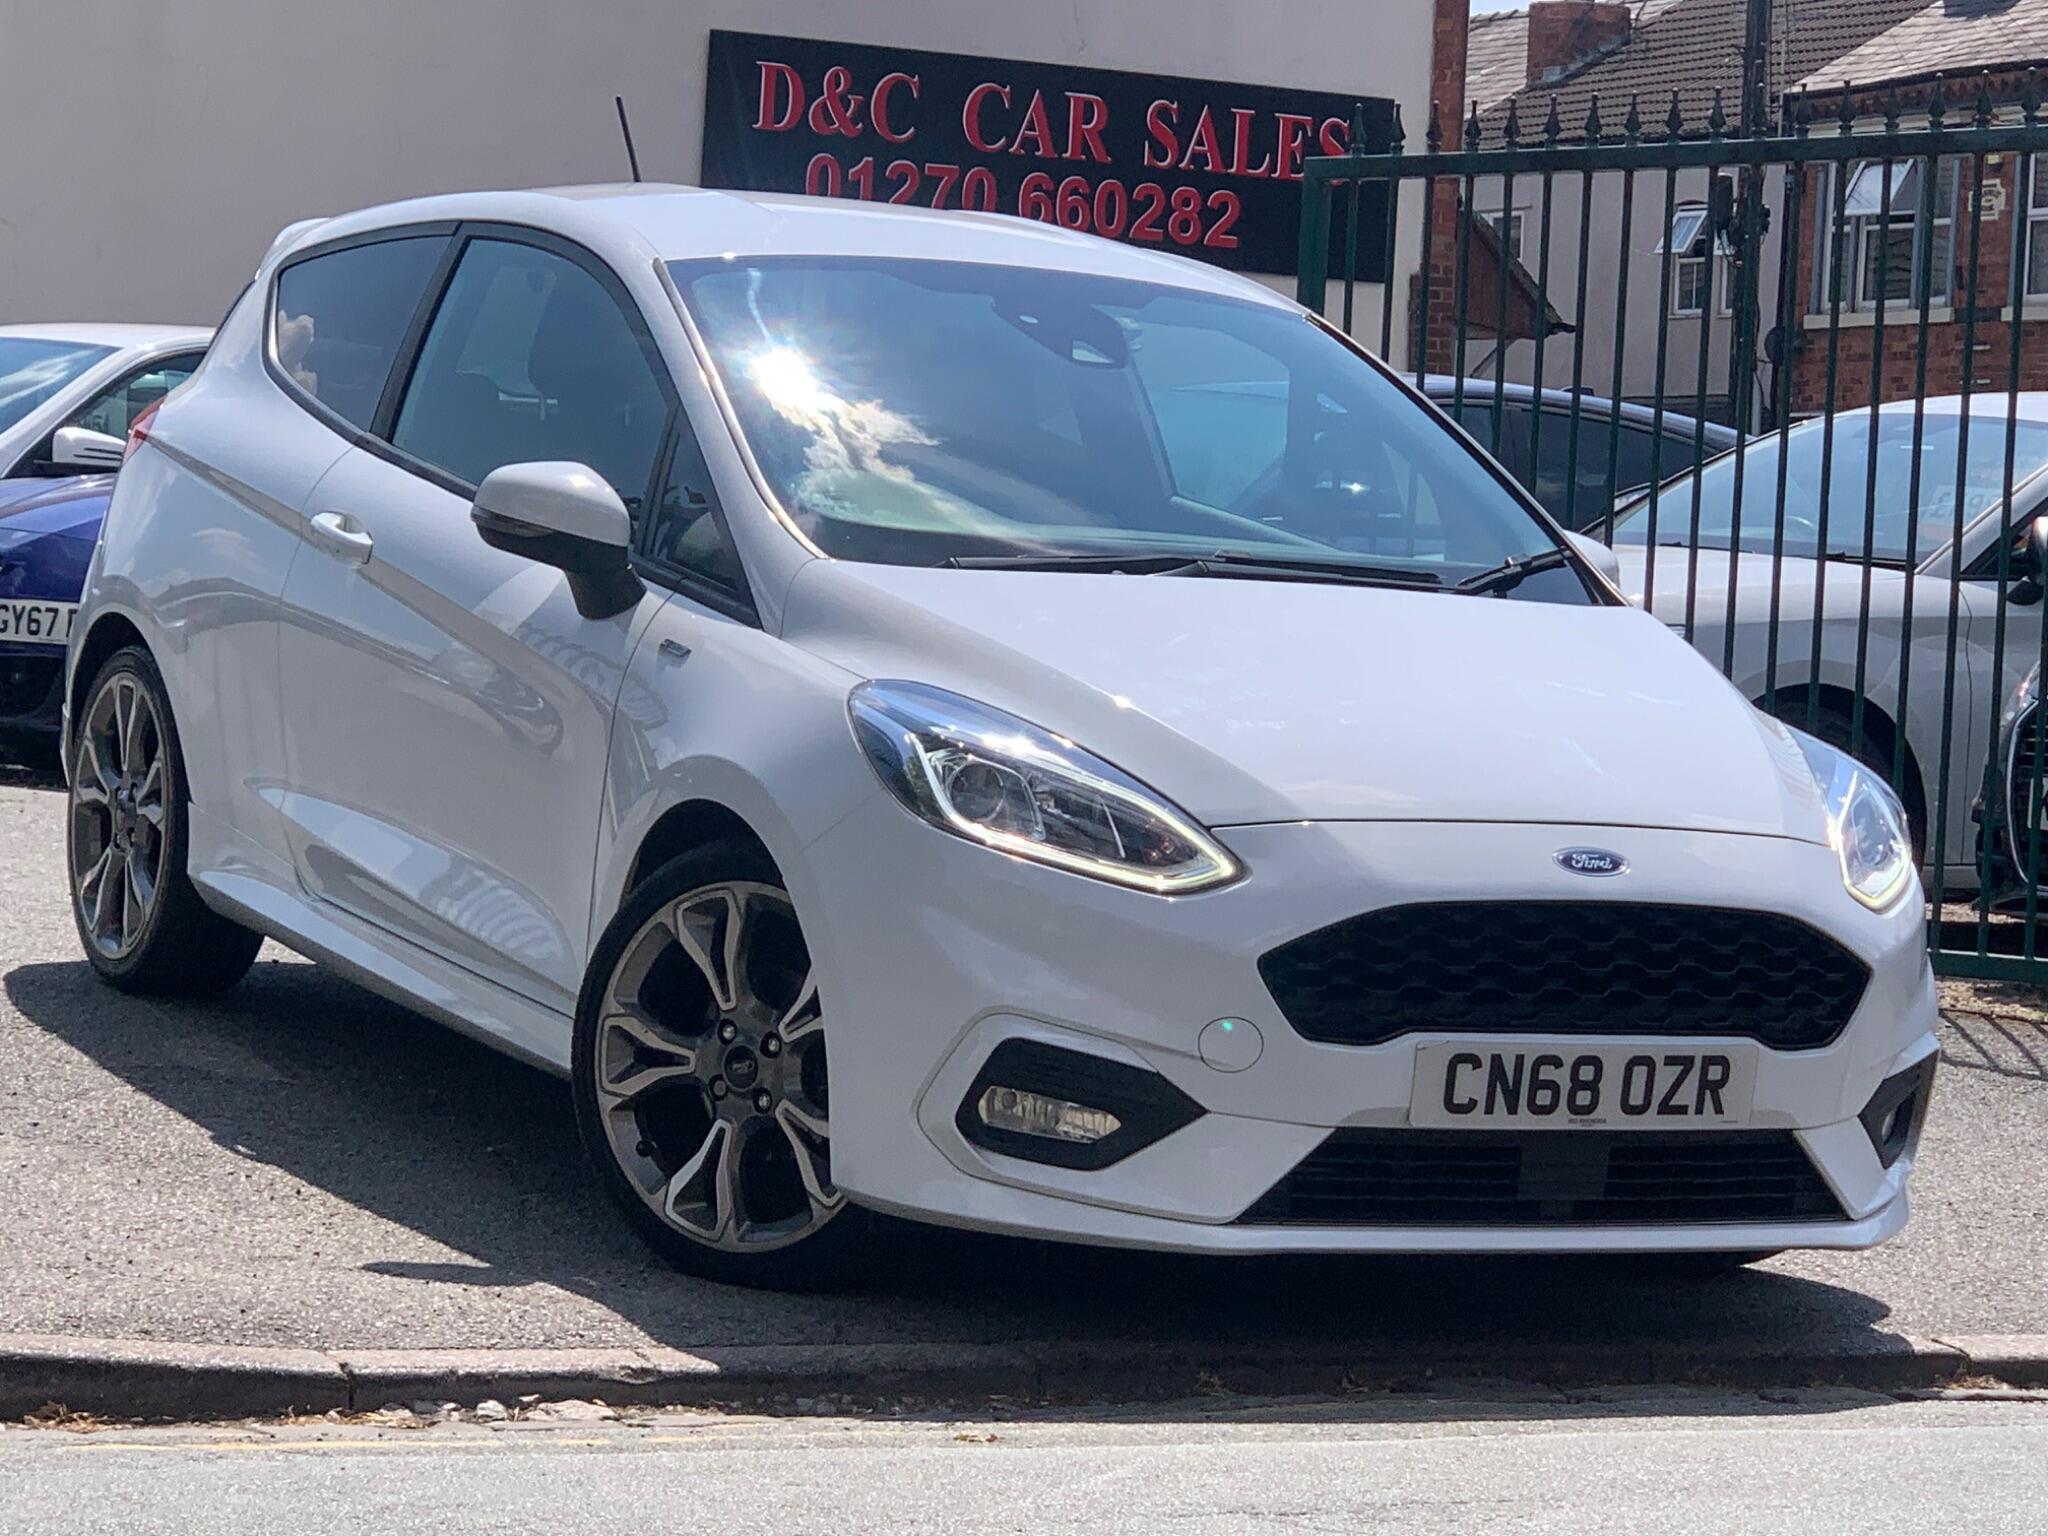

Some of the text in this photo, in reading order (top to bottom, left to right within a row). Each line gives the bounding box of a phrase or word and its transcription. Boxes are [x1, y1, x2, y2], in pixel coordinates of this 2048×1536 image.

[752, 61, 1350, 187] D&C CAR SALES
[805, 153, 1240, 248] 01270 660282
[0, 604, 59, 637] GY67
[1571, 853, 1613, 870] Ford
[1443, 1053, 1730, 1116] CN68 OZR
